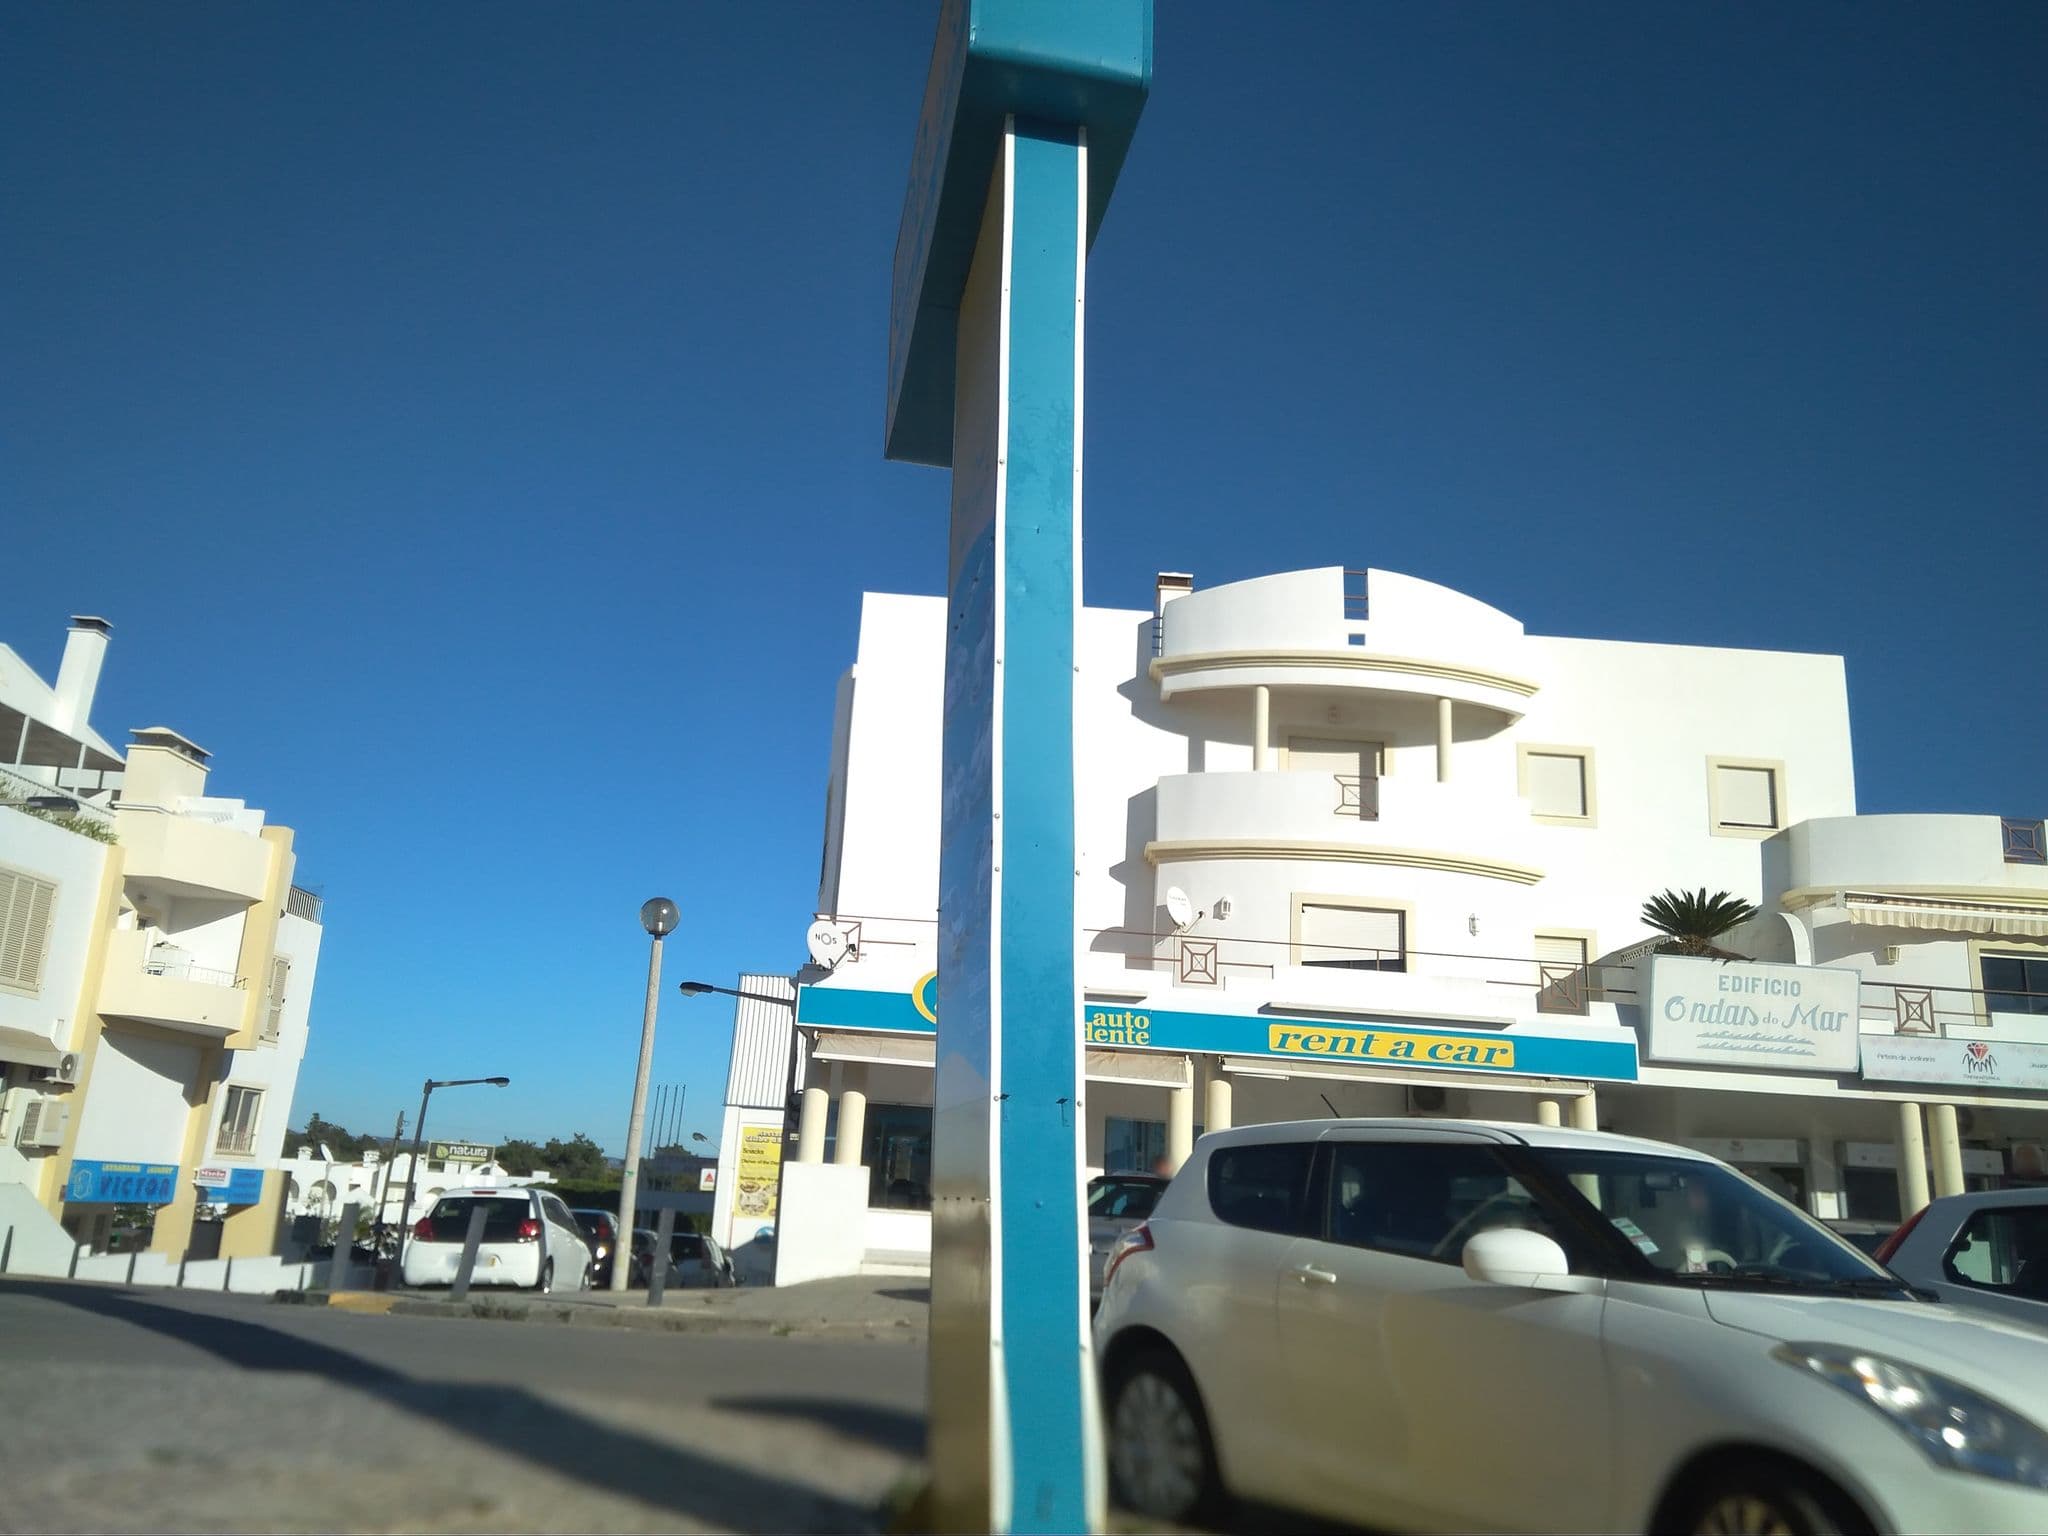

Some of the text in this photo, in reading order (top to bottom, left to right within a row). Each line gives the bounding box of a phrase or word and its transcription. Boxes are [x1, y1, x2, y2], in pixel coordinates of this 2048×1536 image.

[1718, 974, 1802, 997] EDIFICIO
[1093, 1011, 1150, 1030] auto
[1664, 995, 1759, 1027] Ondas
[1781, 1003, 1849, 1033] Mar
[1272, 1031, 1509, 1064] rent a car
[449, 1146, 488, 1157] natura
[100, 1175, 171, 1199] VICTOR
